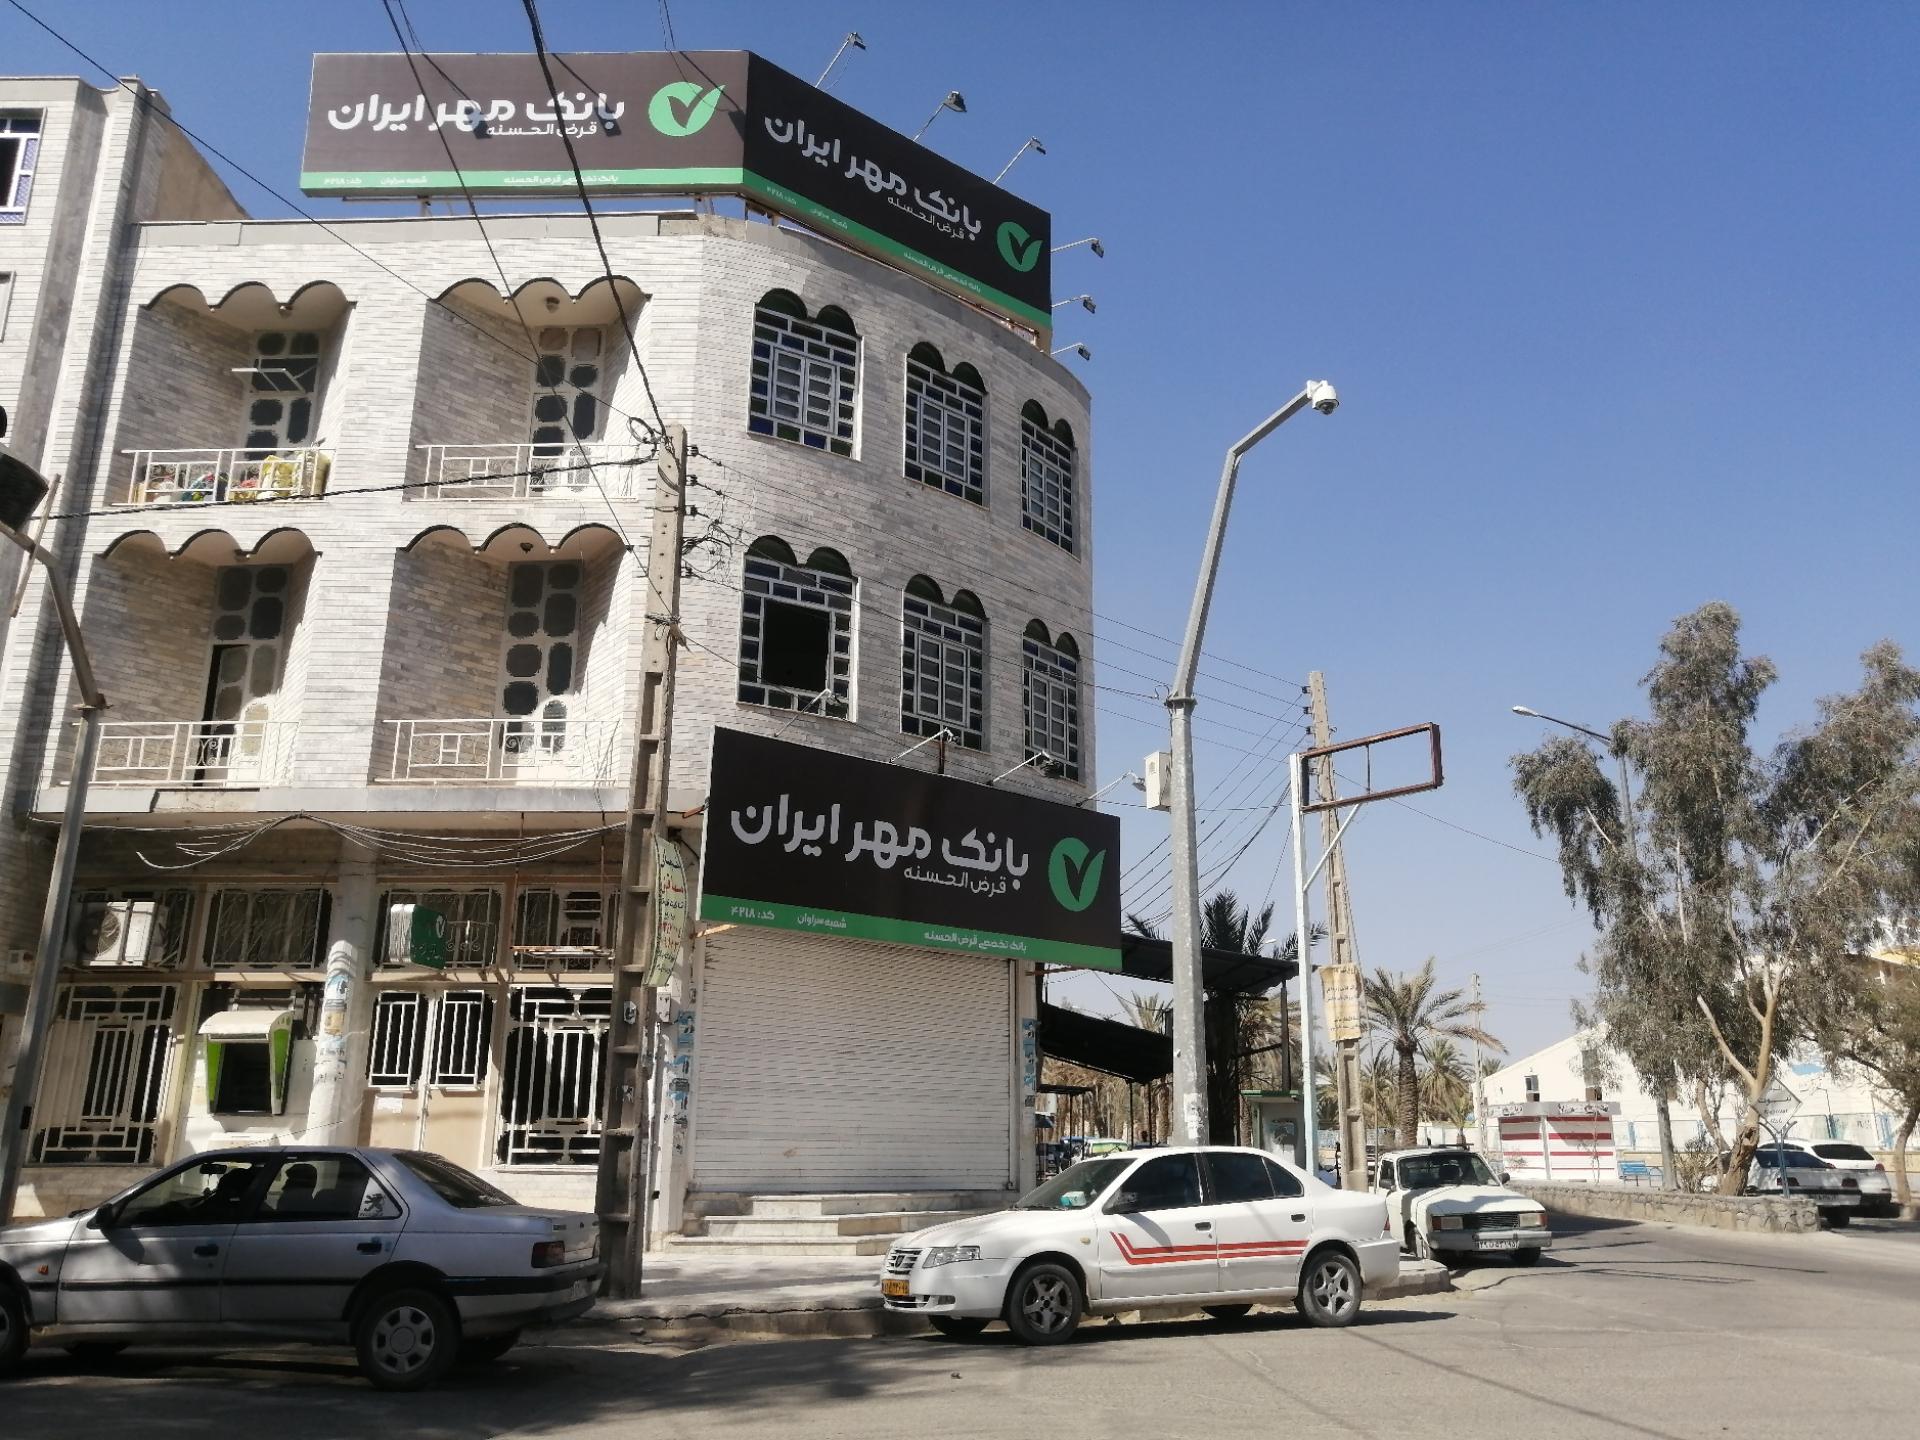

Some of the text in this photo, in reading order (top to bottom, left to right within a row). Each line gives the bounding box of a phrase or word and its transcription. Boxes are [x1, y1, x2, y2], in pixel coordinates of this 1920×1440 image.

[328, 92, 625, 132] بانک مهر ایران
[486, 121, 598, 139] قرض الحسنه
[765, 116, 982, 241] بانک مهر ایران
[887, 196, 965, 241] قرض الحسنه
[730, 793, 1030, 890] بانک مهر ایران
[903, 865, 1007, 899] قرض الحسنه
[797, 912, 847, 930] شعبه سراوان
[923, 930, 958, 943] الحسنه
[958, 934, 978, 948] قرض
[1009, 941, 1027, 954] بانک
